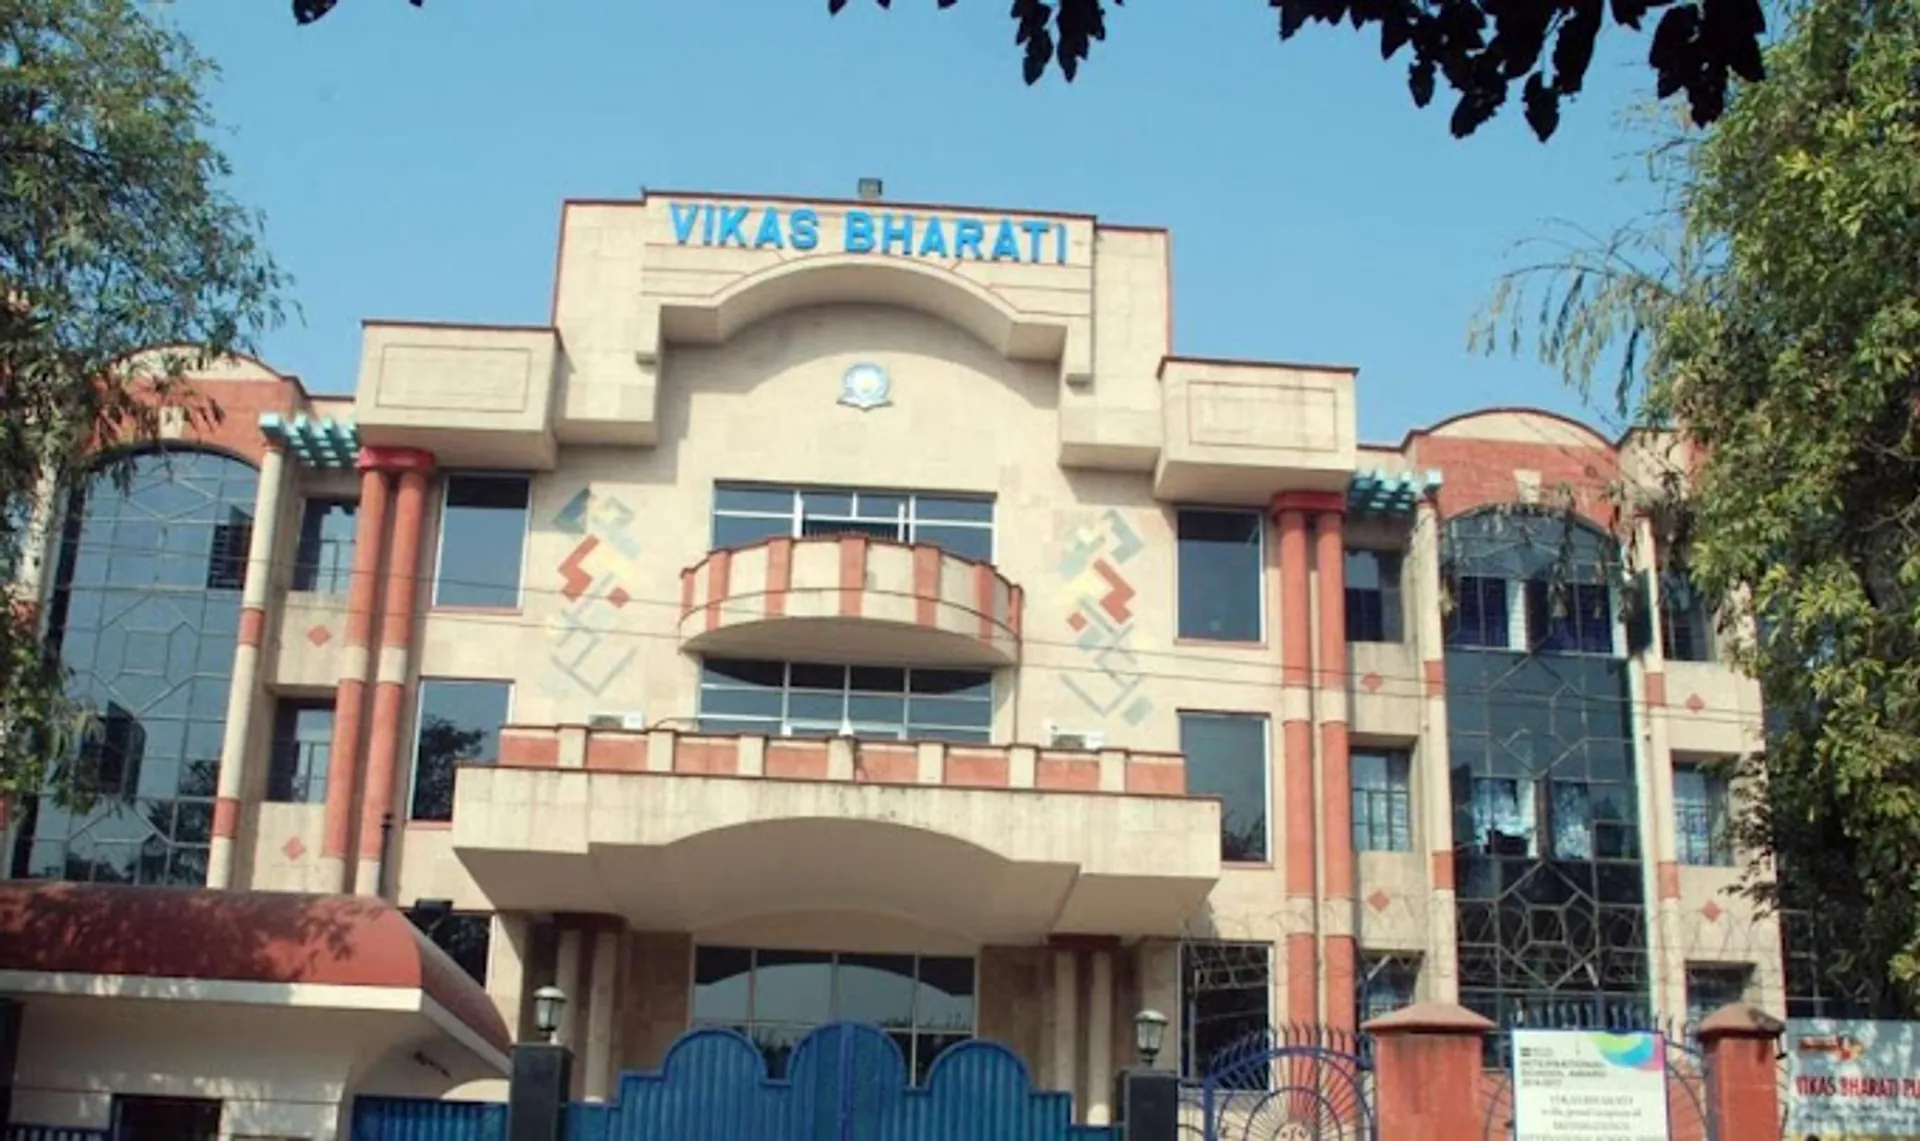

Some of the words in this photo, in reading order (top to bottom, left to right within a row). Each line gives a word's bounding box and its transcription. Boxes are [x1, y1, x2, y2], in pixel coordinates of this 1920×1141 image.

[669, 202, 820, 250] VIKAS
[844, 210, 1069, 265] BHARATI
[1797, 1075, 1836, 1096] VIKAS
[1840, 1076, 1899, 1097] BHARATI
